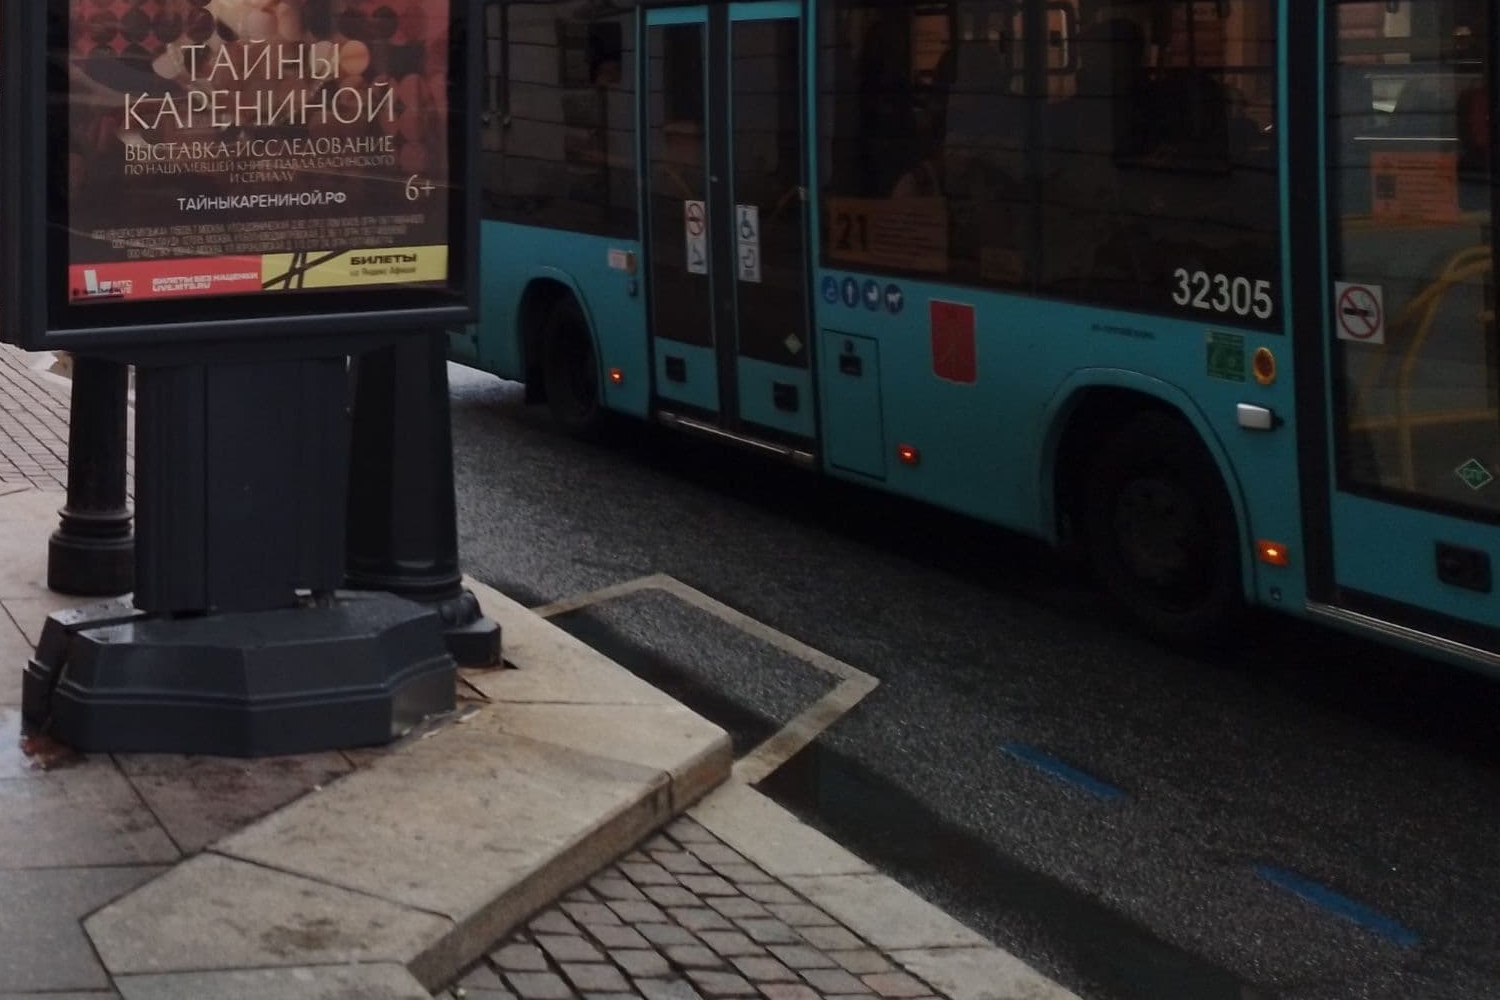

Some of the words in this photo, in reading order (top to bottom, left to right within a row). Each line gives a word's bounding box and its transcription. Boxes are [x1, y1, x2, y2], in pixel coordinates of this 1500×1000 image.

[180, 39, 340, 82] ТАЙНЫ
[123, 81, 395, 131] КАРЕНИНОЙ
[124, 135, 395, 162] ВЫСТАВКА-ИССЛЕДОВАНИЕ
[124, 163, 143, 176] ПО
[229, 172, 240, 184] И
[176, 190, 347, 211] ТАЙНЫКАРЕНИНОЙ.РФ
[404, 173, 436, 201] 6+
[350, 253, 417, 266] БИЛЕТЫ
[1172, 268, 1273, 319] 32305
